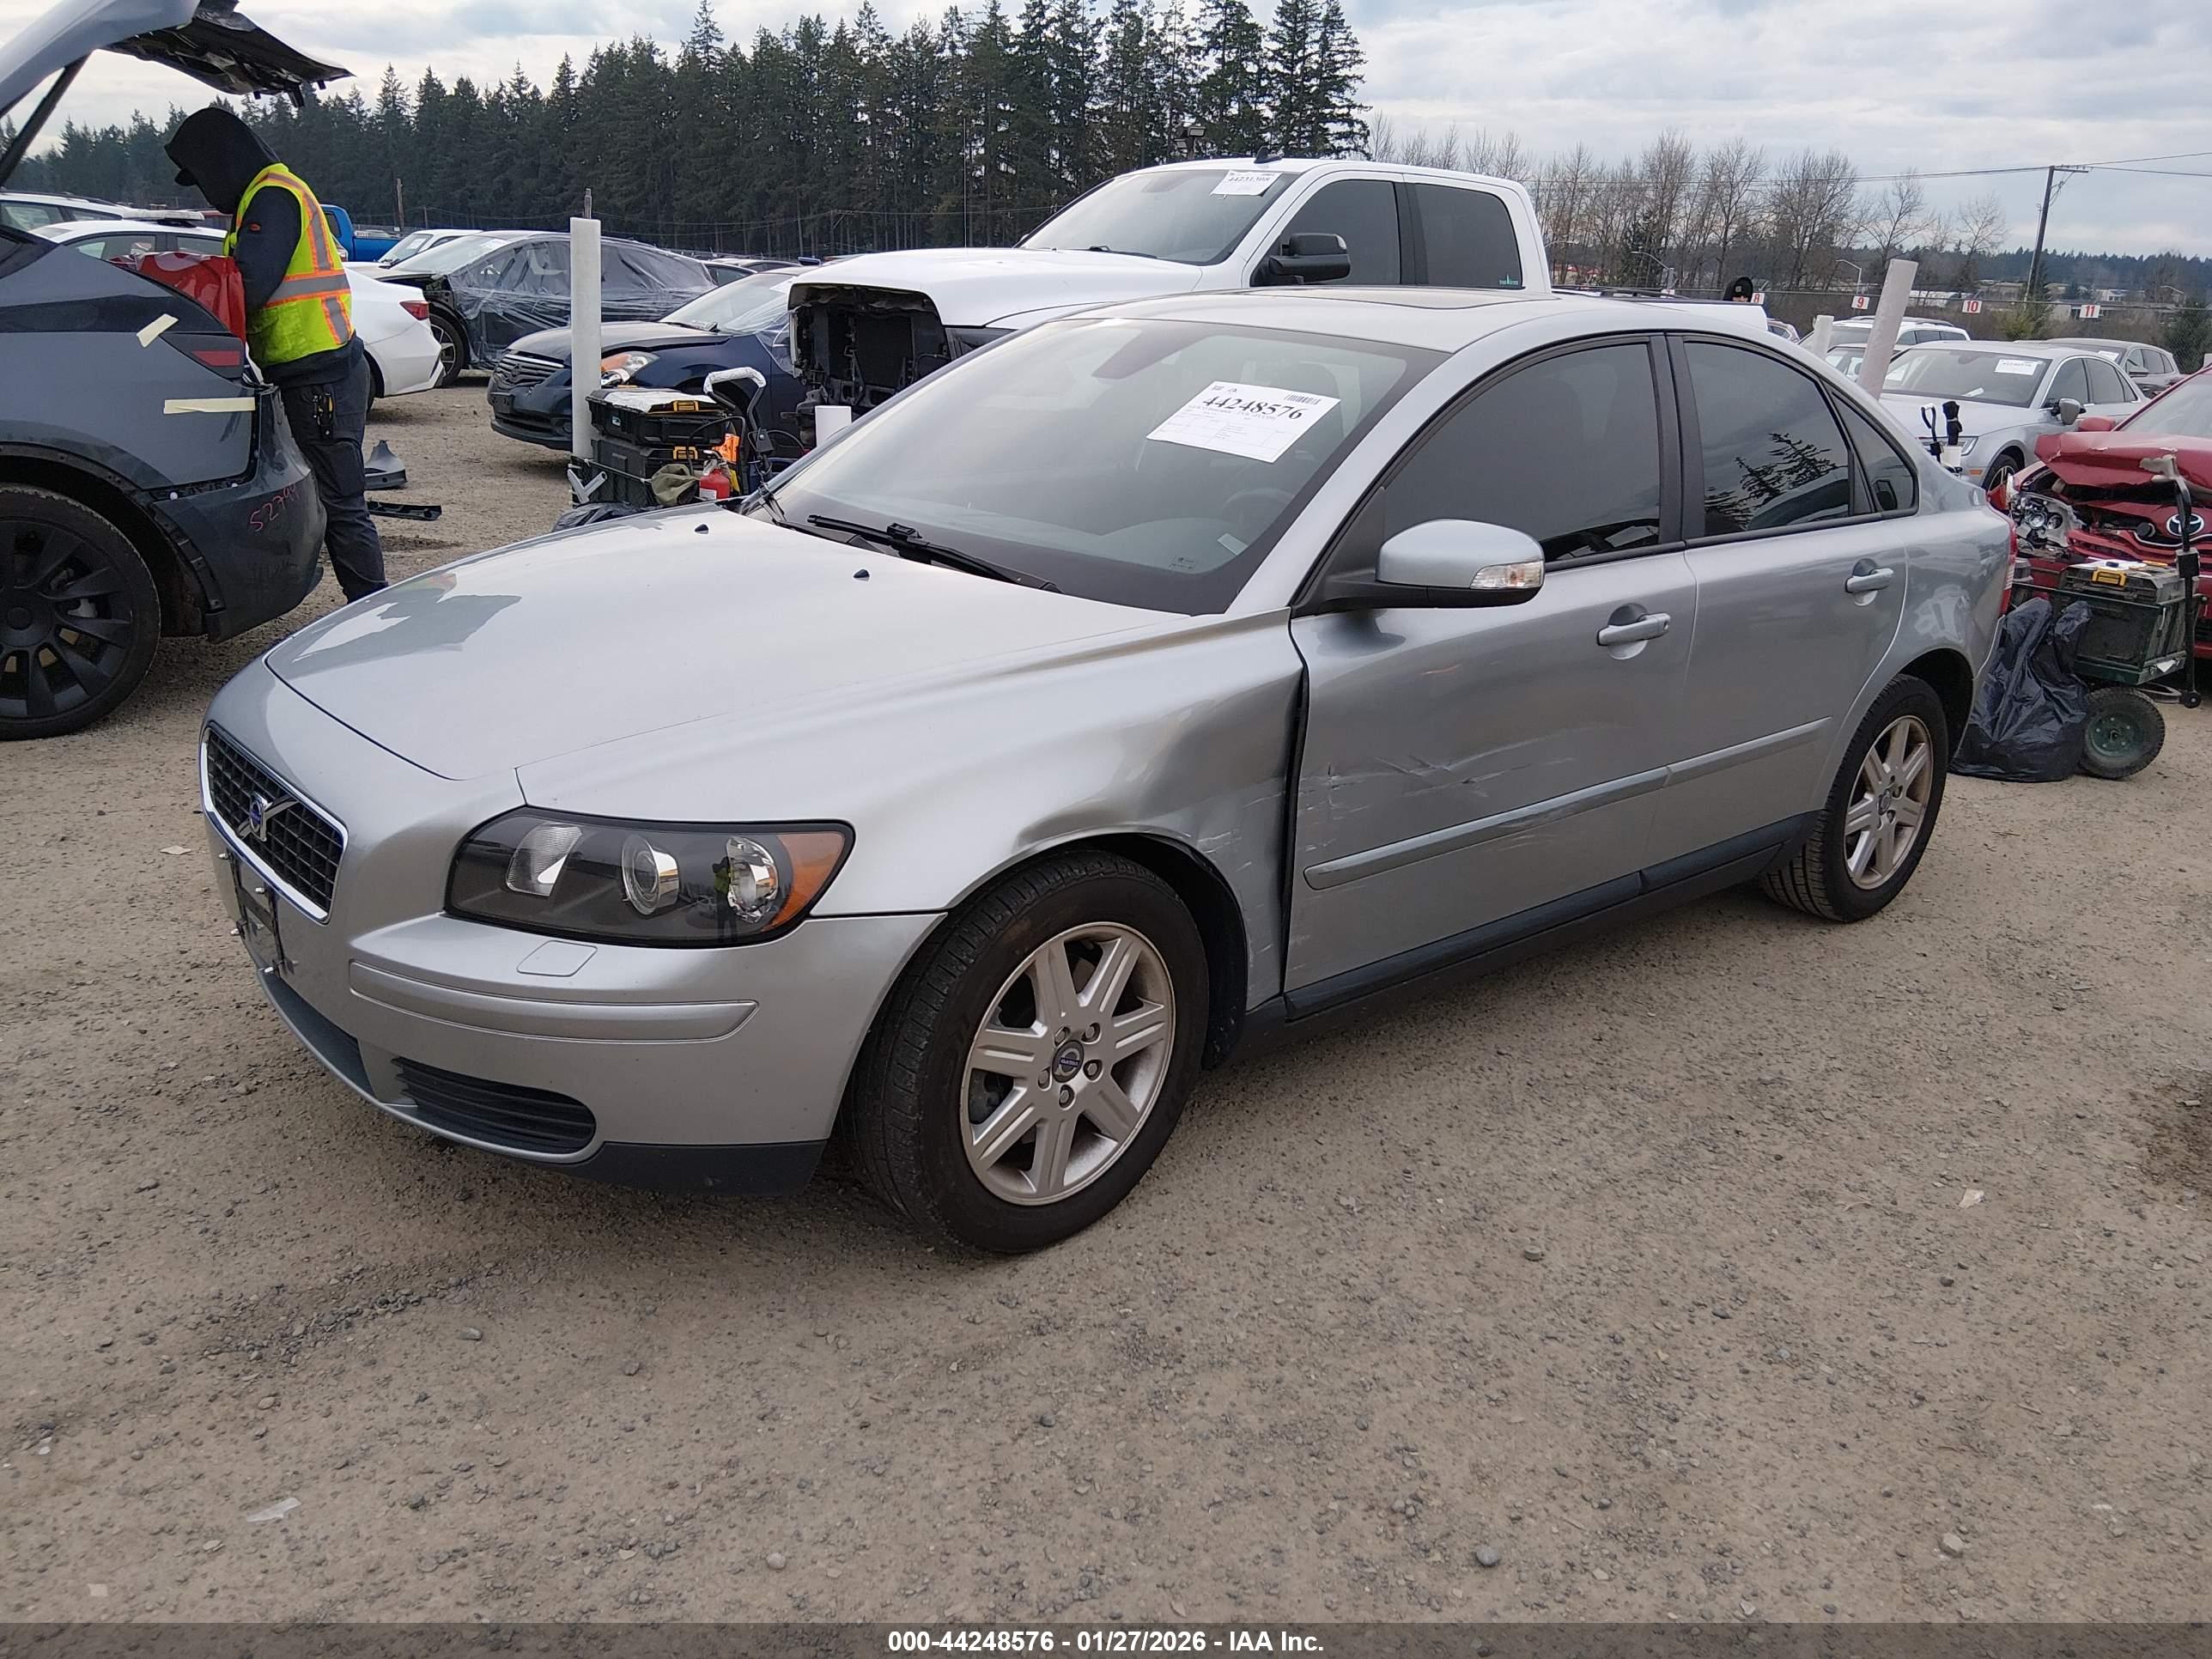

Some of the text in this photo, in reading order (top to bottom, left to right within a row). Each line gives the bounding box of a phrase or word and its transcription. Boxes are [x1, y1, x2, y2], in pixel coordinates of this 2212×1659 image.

[1857, 297, 1865, 307] 9
[1966, 301, 1979, 313] 10
[2086, 306, 2096, 317] 11
[1201, 394, 1307, 421] 44248576
